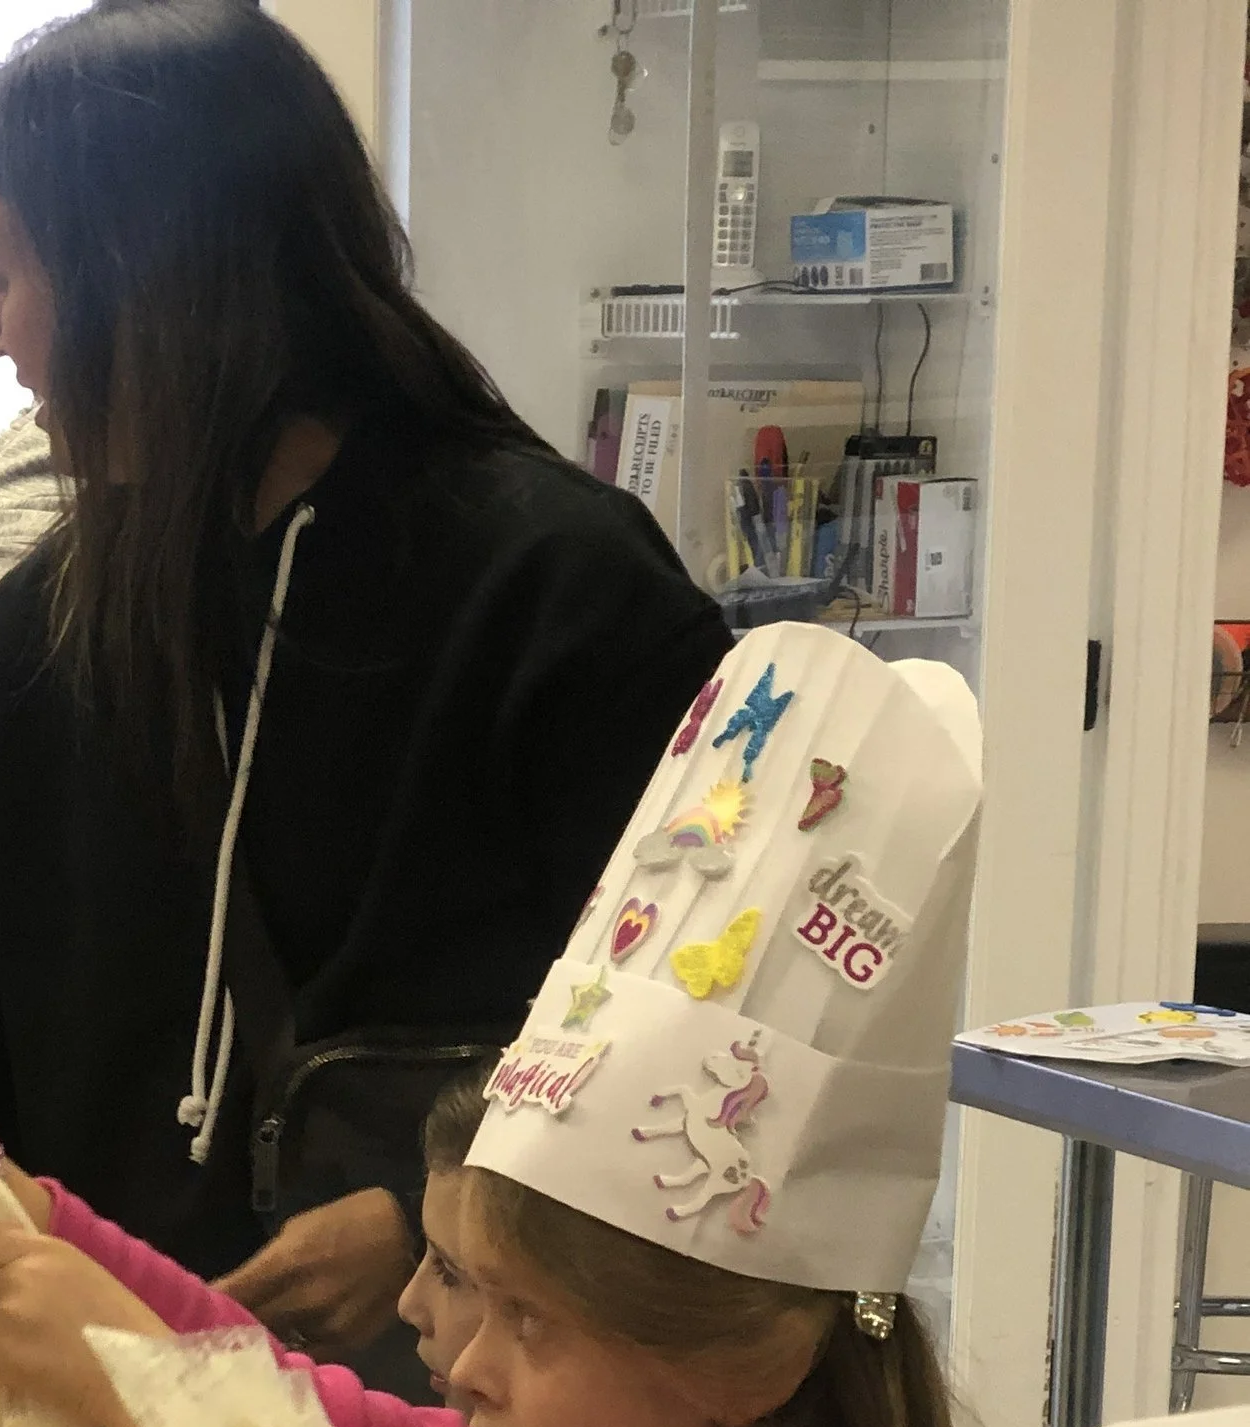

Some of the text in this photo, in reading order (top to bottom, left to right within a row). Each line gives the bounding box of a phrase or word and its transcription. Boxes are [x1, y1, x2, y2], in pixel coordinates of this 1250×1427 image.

[877, 529, 890, 614] Sharpie
[797, 902, 883, 983] BIG
[808, 861, 907, 960] dream
